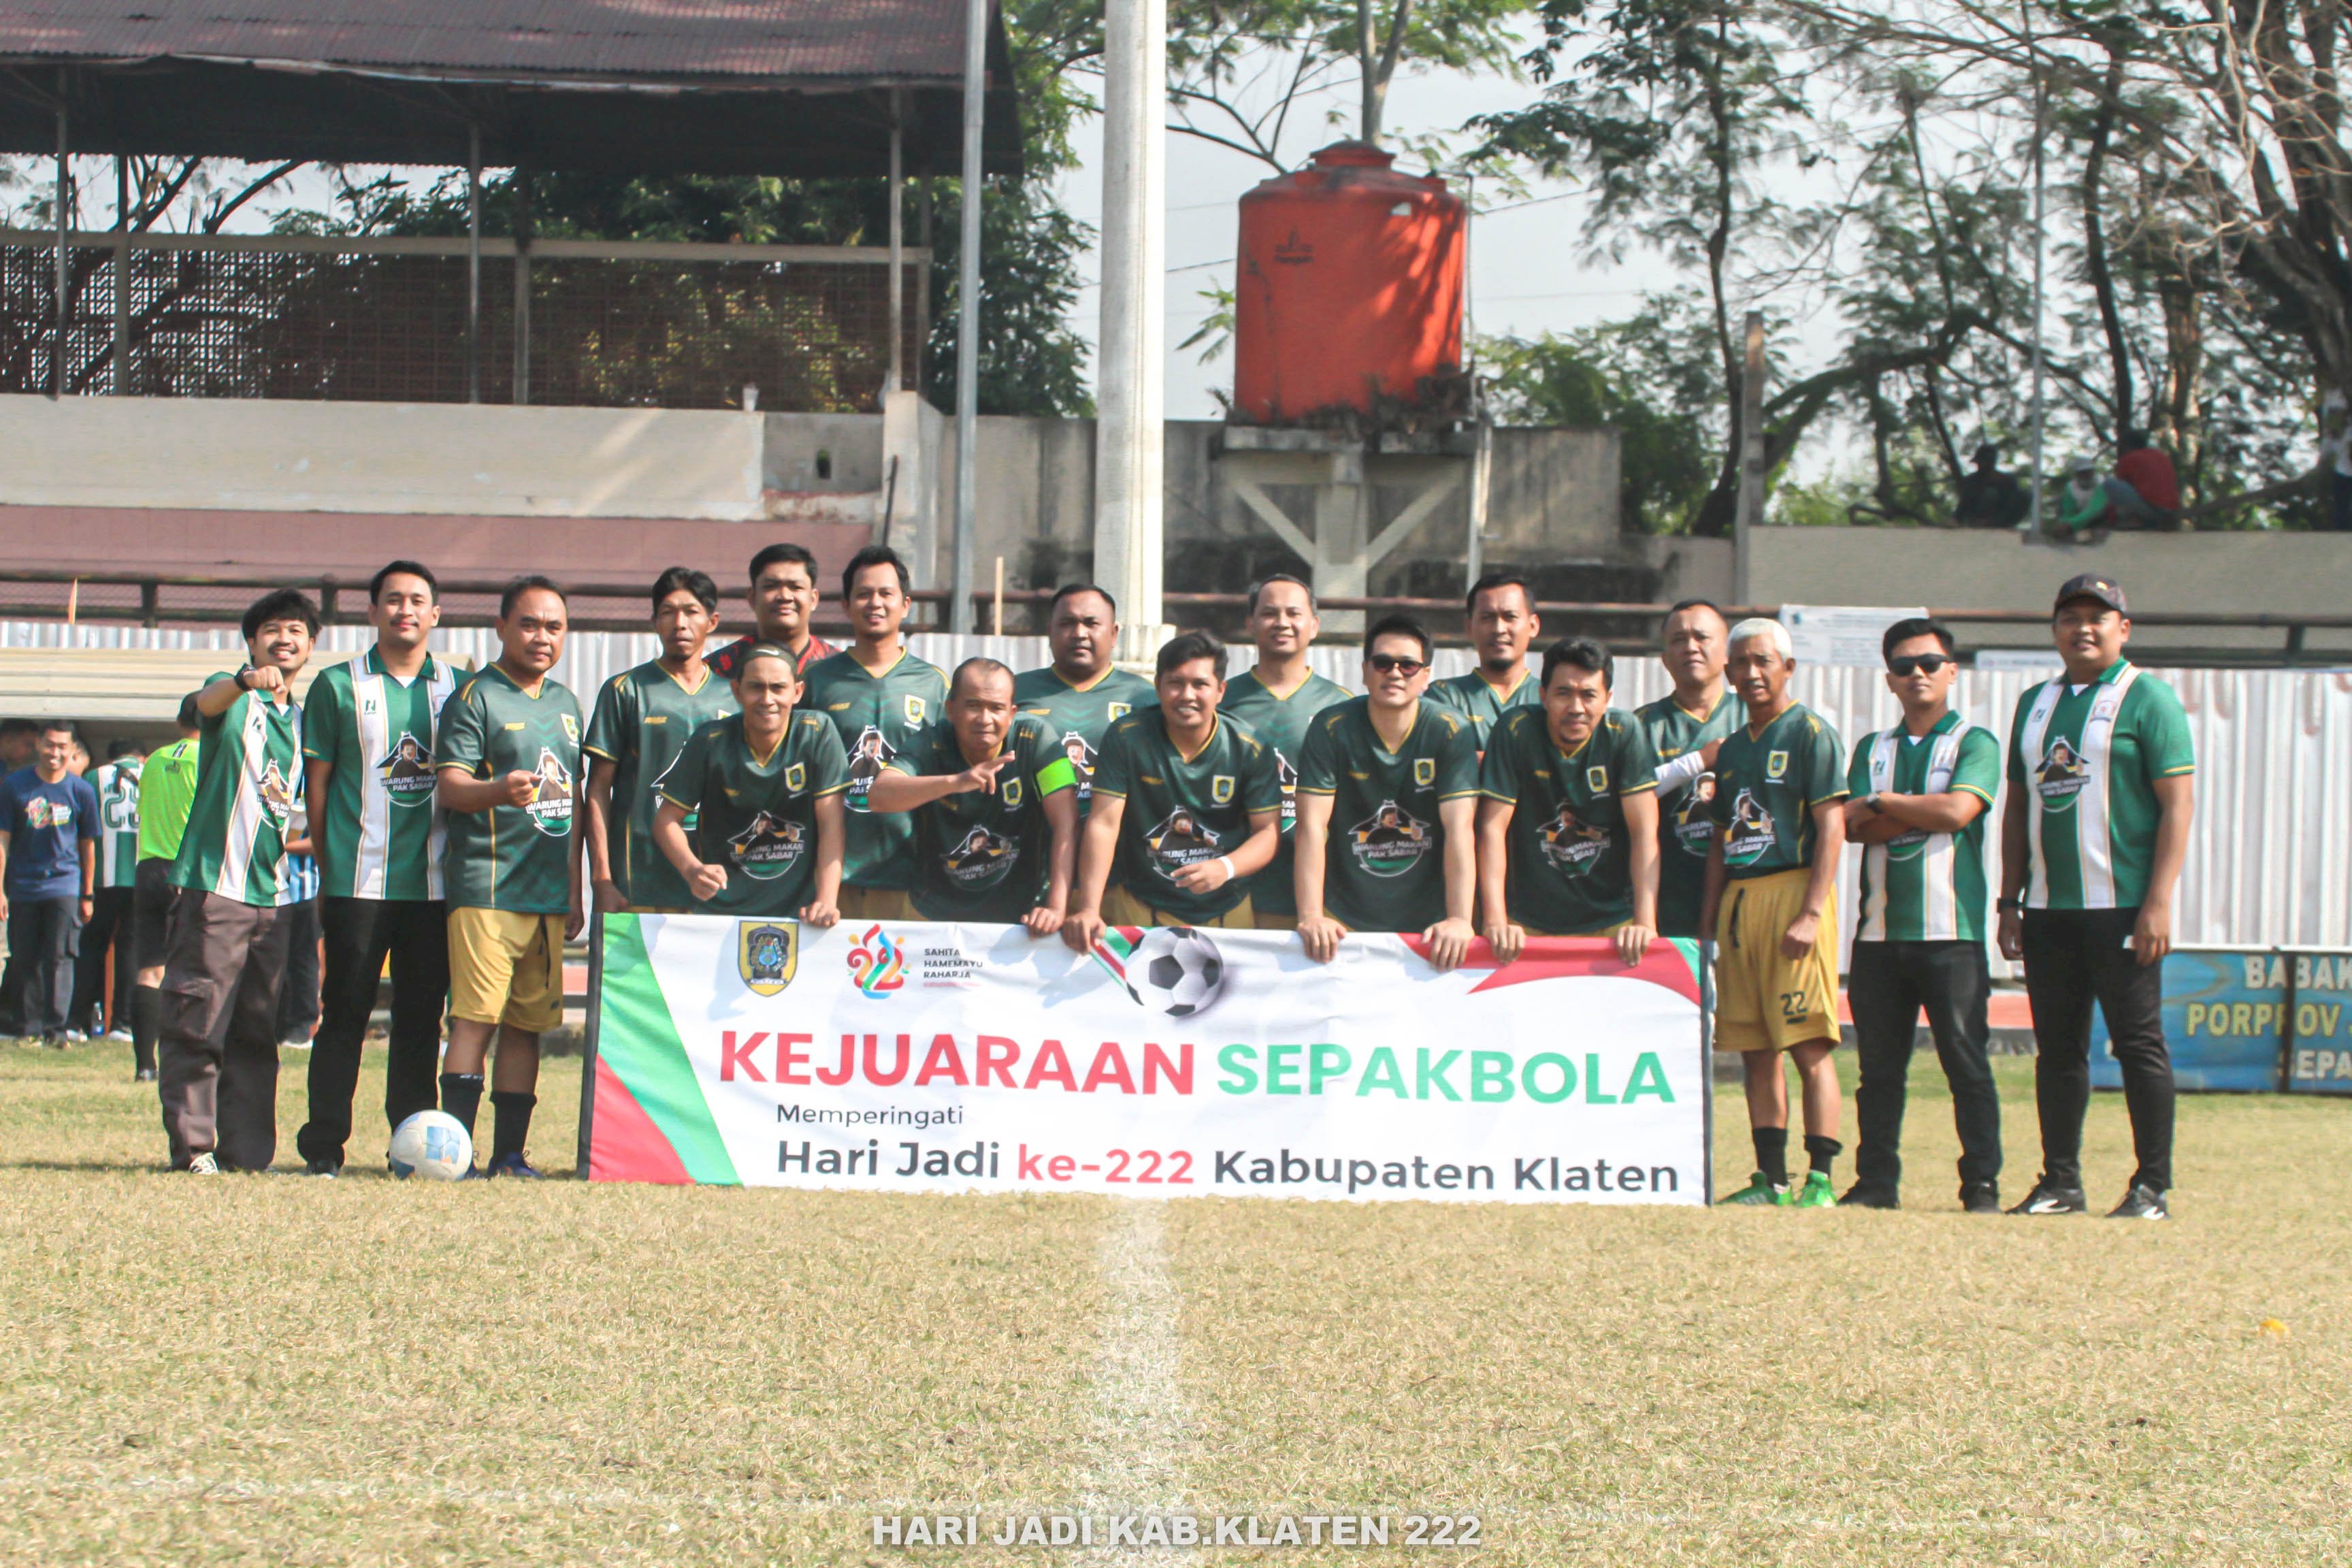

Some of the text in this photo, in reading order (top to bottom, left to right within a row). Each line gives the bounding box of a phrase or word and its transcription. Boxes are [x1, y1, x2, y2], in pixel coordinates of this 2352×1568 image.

[380, 774, 437, 785] WARUNG MAKA
[528, 799, 561, 811] WARUNG
[542, 808, 557, 818] PAK
[924, 948, 961, 956] SAHITA
[924, 960, 983, 968] HAMEMAYU
[924, 970, 971, 979] RAHARJA
[720, 1030, 1676, 1105] KEJUARAAN SEPAKBOLA
[777, 1104, 963, 1130] Memperingati
[777, 1139, 1678, 1194] Hari Jadi ke-222 Kabupaten Klaten
